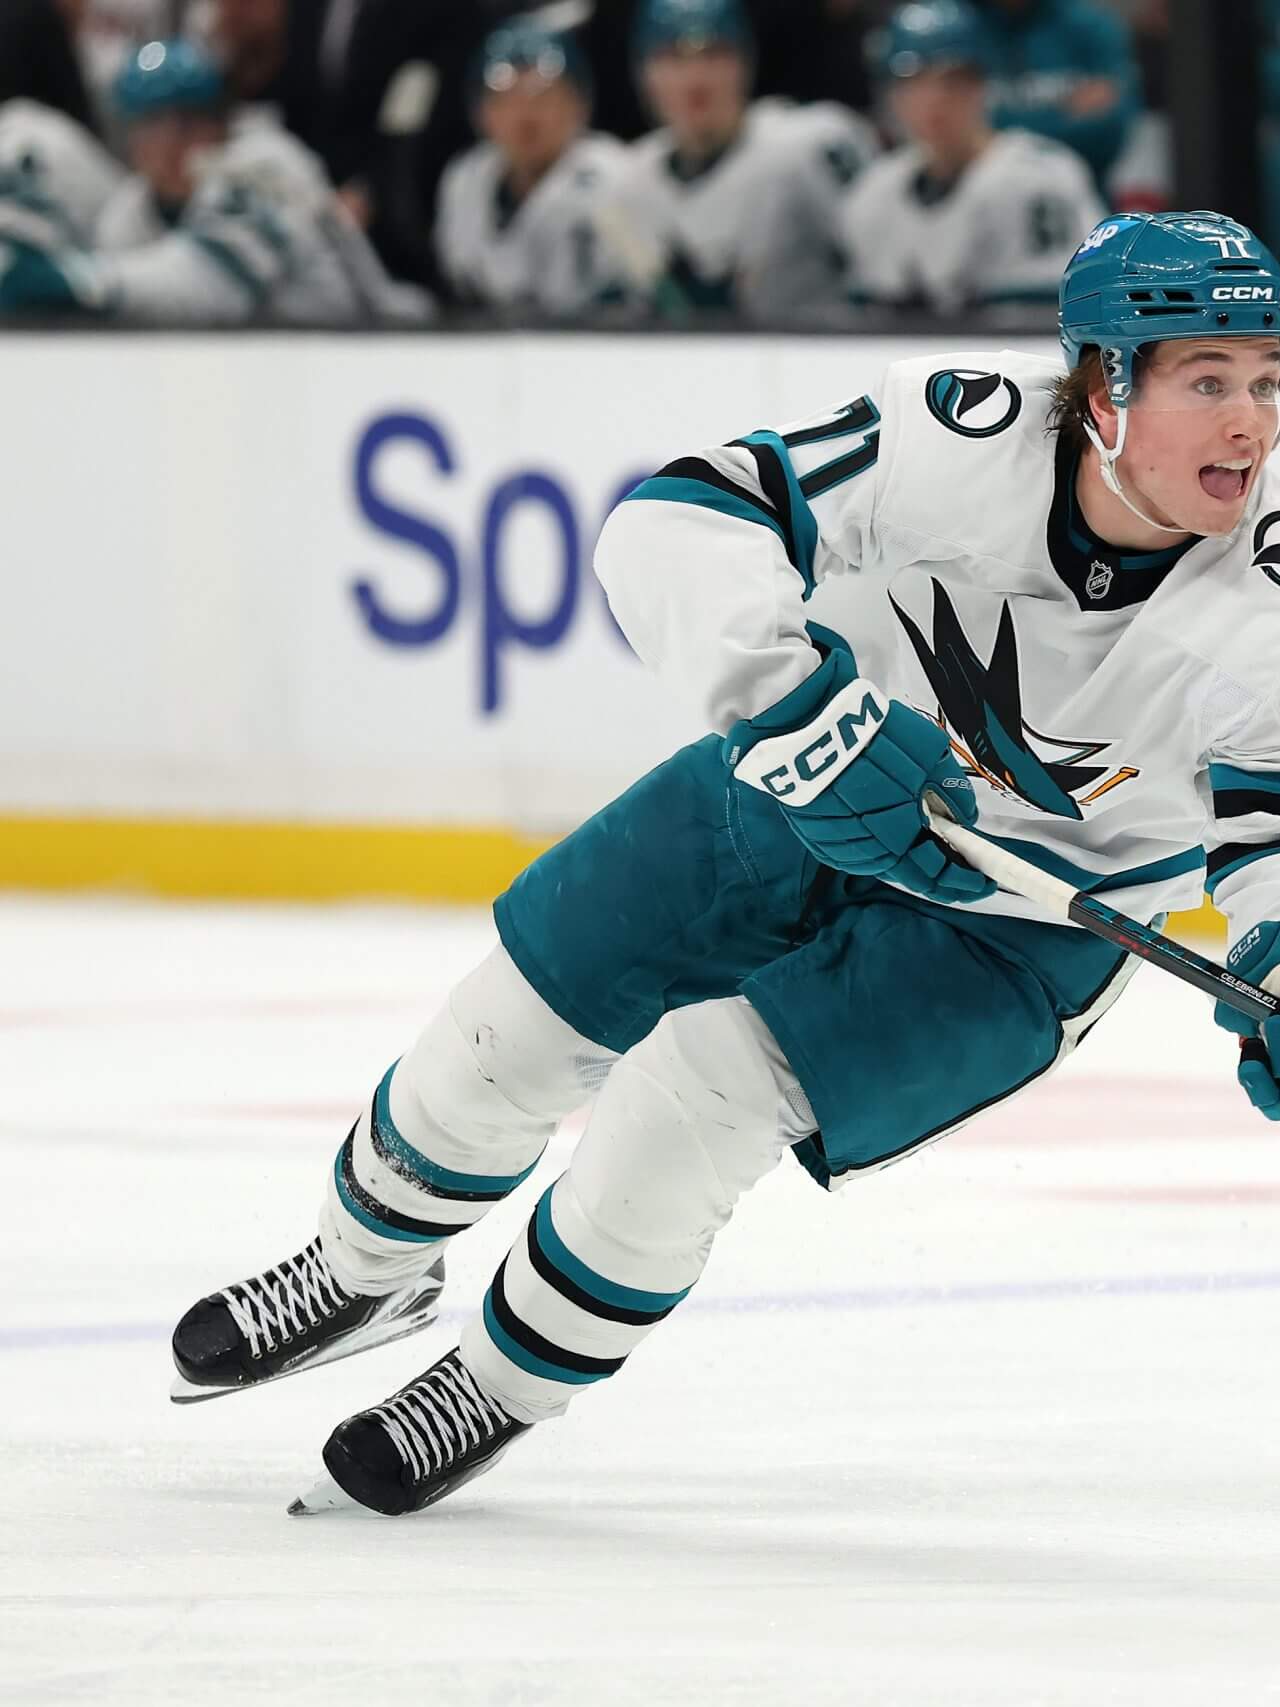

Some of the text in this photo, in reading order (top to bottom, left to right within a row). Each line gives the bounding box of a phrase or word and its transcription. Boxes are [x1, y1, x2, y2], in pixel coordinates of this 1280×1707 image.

[1078, 224, 1120, 254] SAP
[1211, 286, 1273, 300] CCM
[781, 394, 881, 501] 71
[760, 691, 884, 797] CCM
[1229, 927, 1260, 963] CCM
[1220, 972, 1263, 998] CELEBRINI
